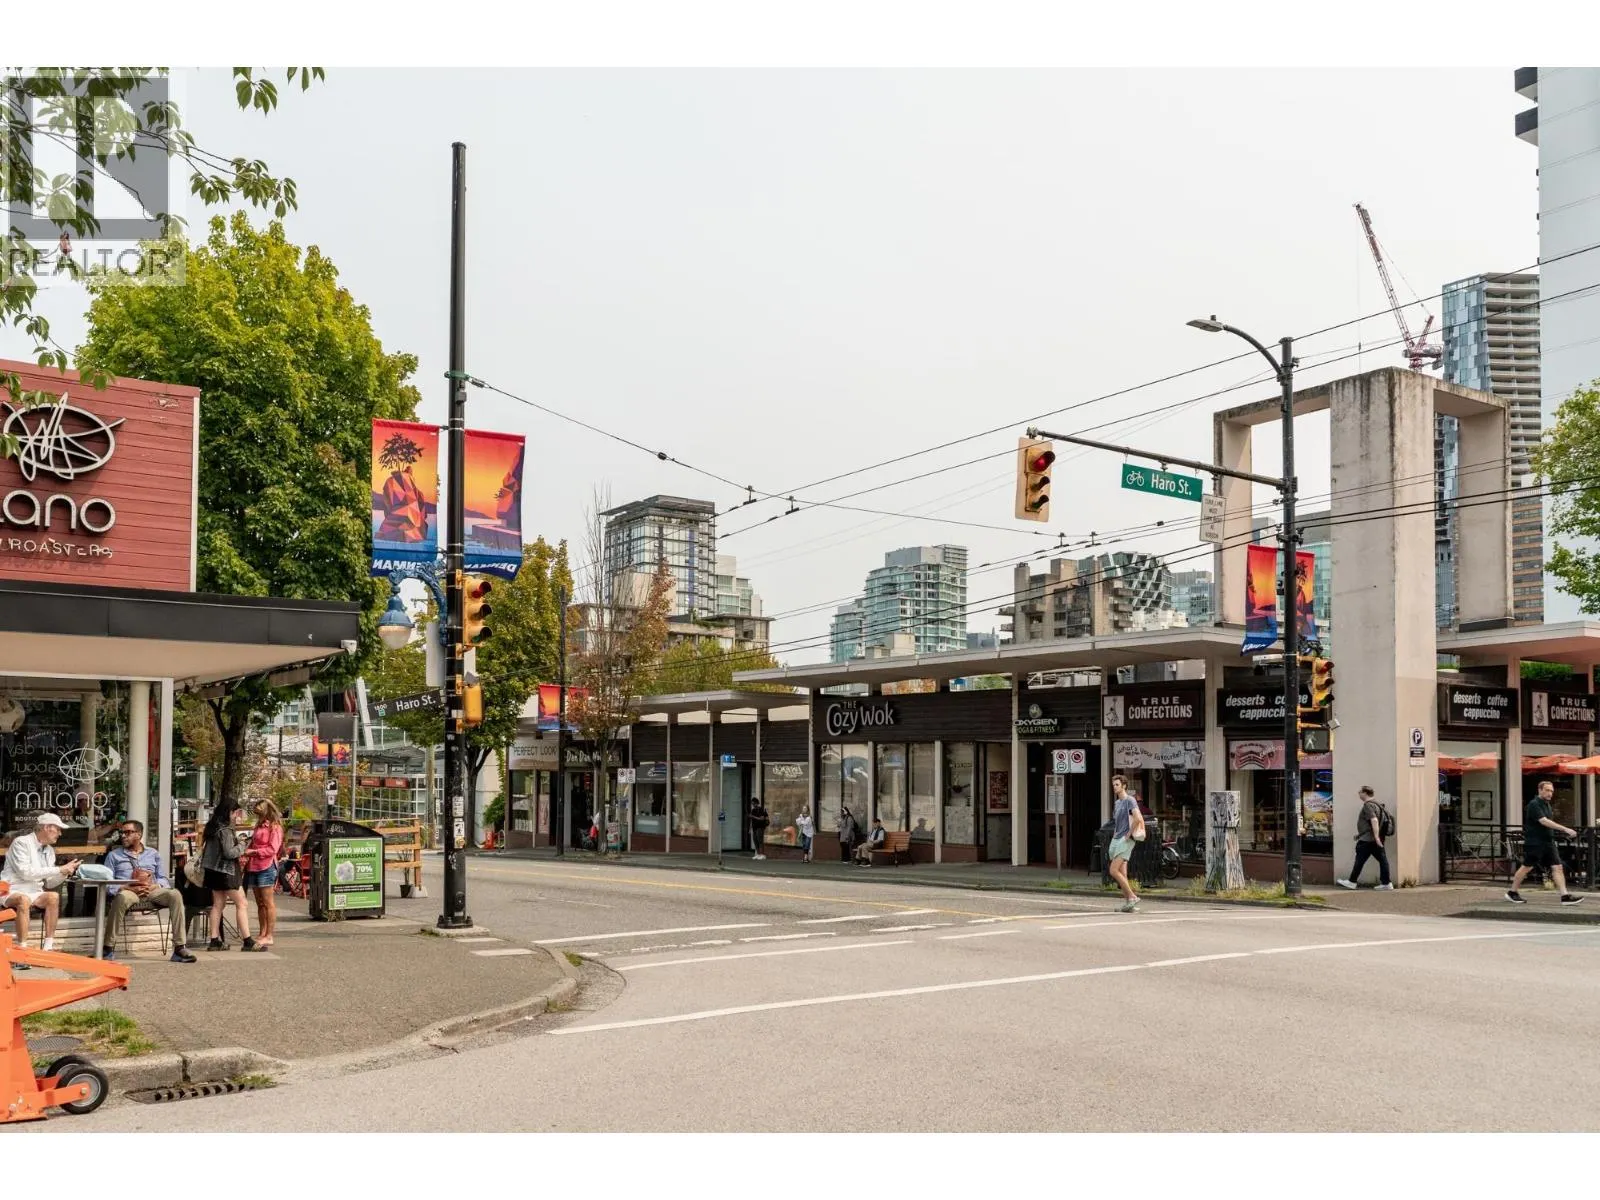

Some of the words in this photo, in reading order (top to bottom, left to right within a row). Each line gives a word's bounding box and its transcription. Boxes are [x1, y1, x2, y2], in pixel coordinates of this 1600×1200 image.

[1151, 473, 1176, 492] Haro
[1178, 479, 1192, 496] St.
[0, 489, 116, 533] ano
[395, 699, 420, 712] Haro
[421, 694, 436, 706] St.
[843, 701, 857, 709] THE
[1141, 696, 1180, 705] TRUE
[1225, 694, 1265, 707] desserts
[1453, 691, 1482, 705] desserts
[1487, 695, 1508, 707] coffee
[1560, 697, 1587, 707] TRUE
[826, 703, 858, 736] Cozy
[860, 700, 895, 726] Wok
[1128, 704, 1193, 719] CONFECTIONS
[1463, 707, 1500, 720] cappuccino
[1551, 705, 1596, 722] CONFECTIONS
[1013, 718, 1058, 726] OXYGEN
[513, 746, 538, 757] PERFECT
[540, 745, 557, 756] LOOK
[566, 750, 578, 762] Dan
[15, 786, 108, 809] milano
[356, 865, 373, 873] 70%
